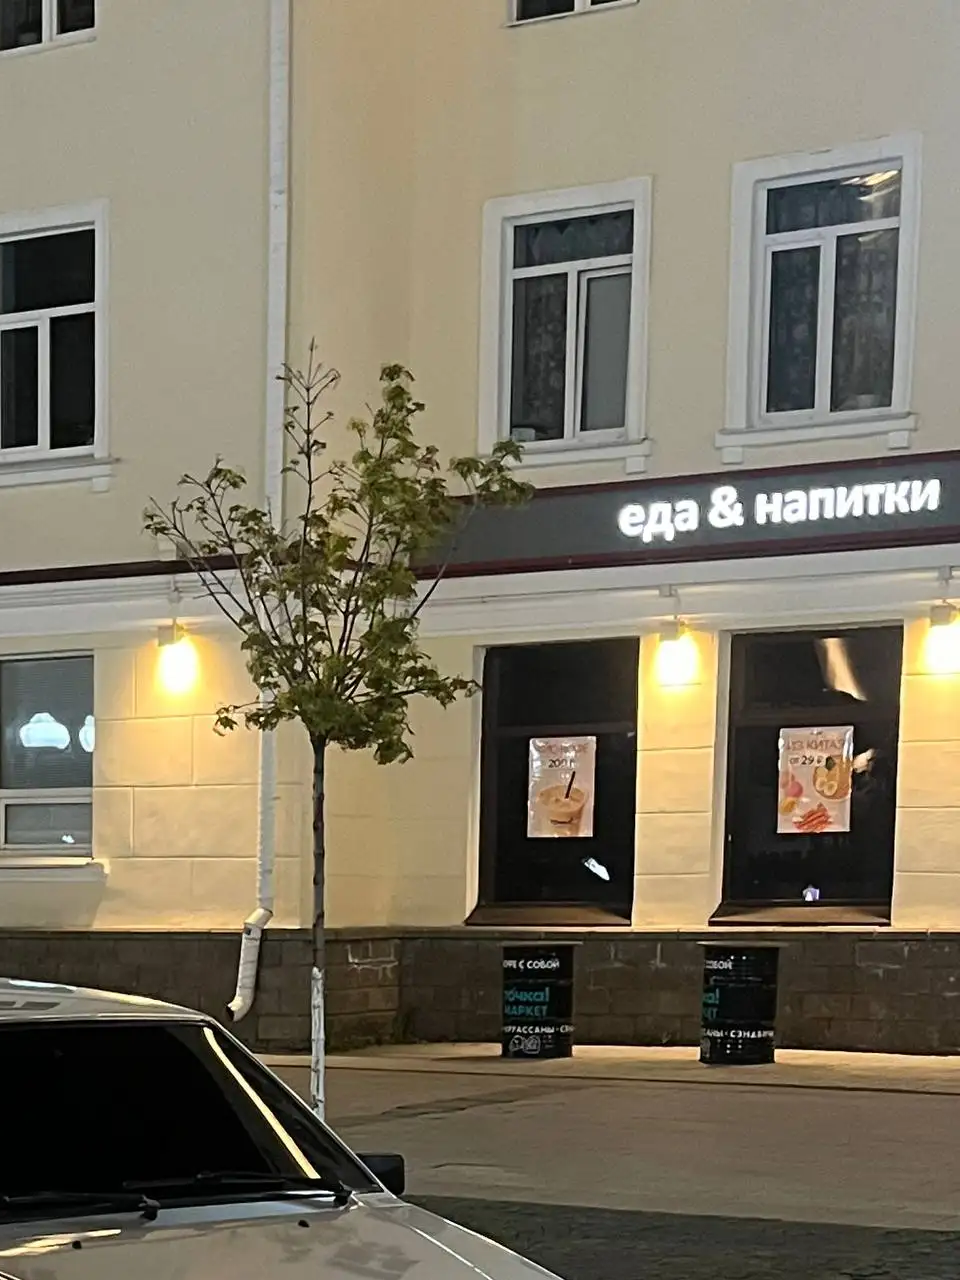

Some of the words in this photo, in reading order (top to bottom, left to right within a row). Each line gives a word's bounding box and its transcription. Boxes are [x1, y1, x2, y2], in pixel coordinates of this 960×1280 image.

[617, 498, 700, 544] еда
[707, 485, 745, 529] &
[754, 478, 941, 526] напитки
